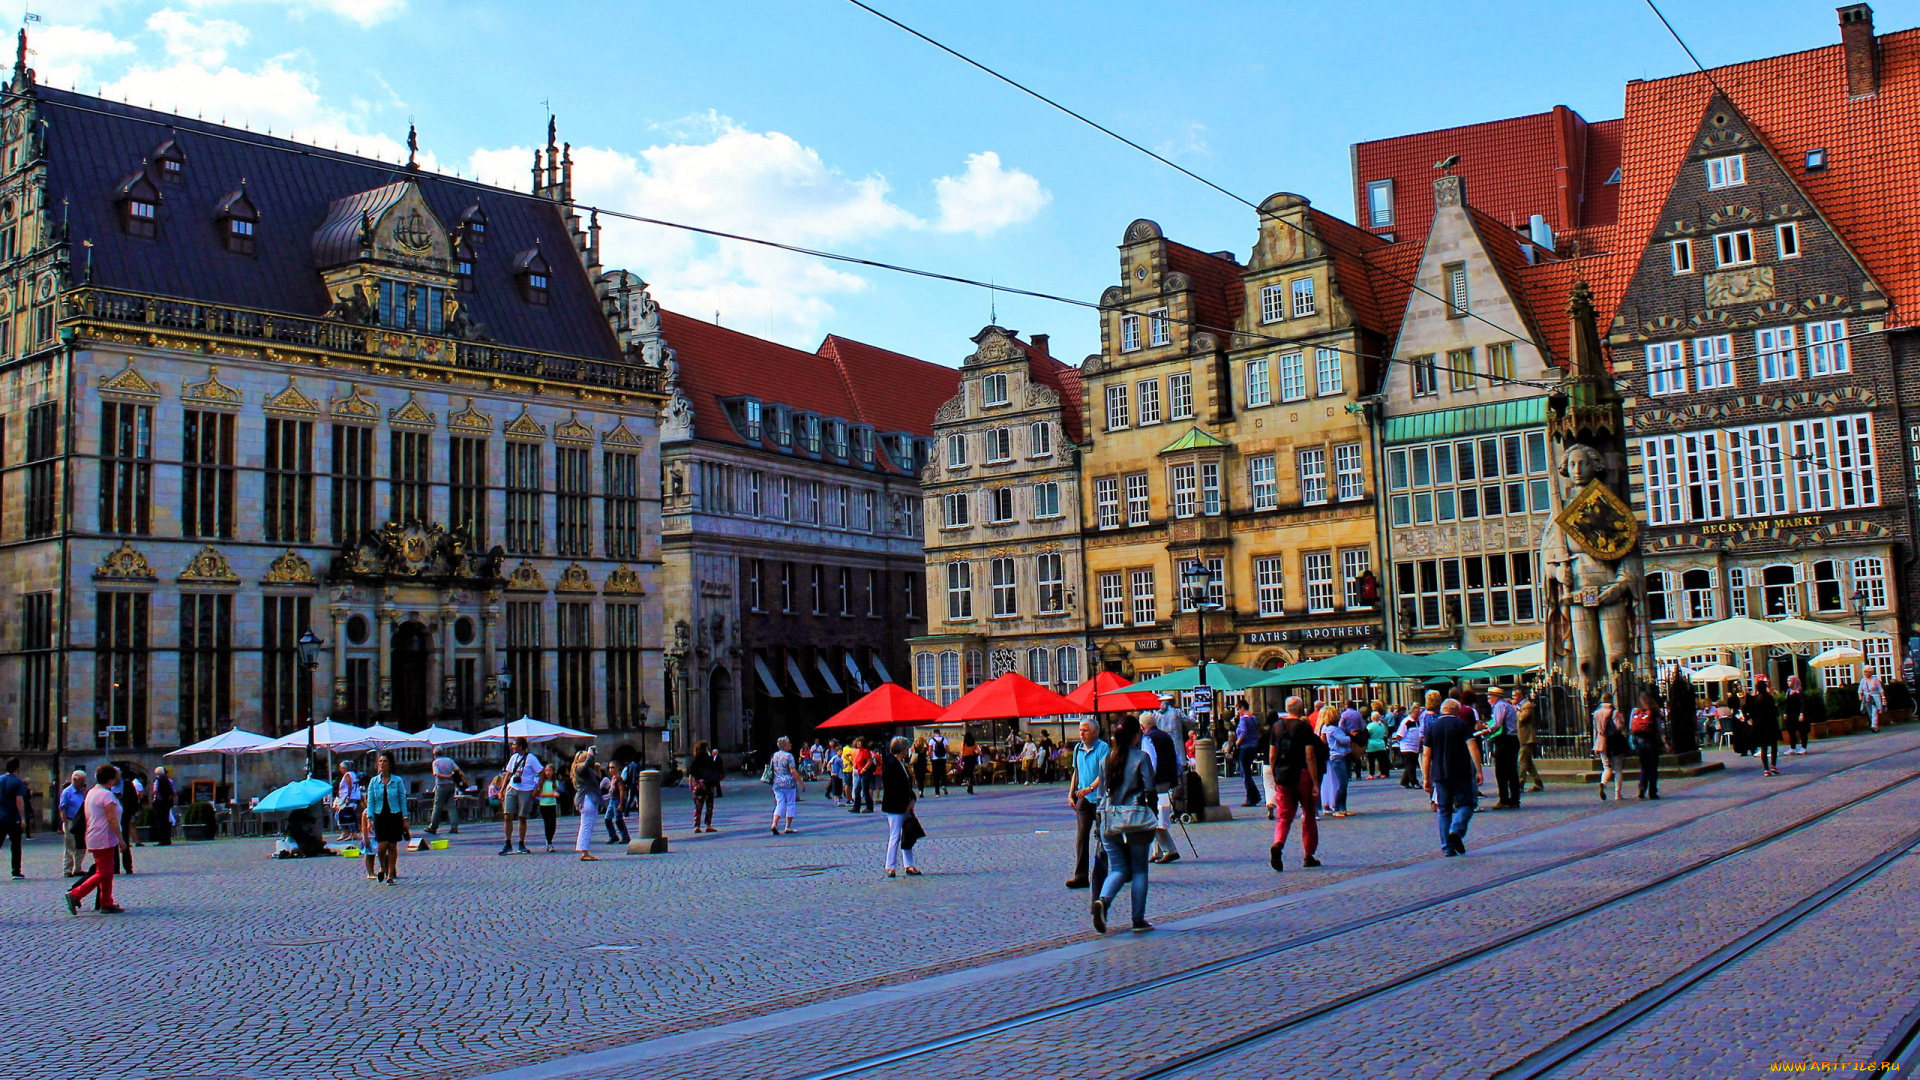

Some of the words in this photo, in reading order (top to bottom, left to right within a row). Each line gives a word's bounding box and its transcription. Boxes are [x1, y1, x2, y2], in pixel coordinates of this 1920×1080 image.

[1749, 520, 1769, 530] AM
[1774, 515, 1822, 529] MARKT
[1251, 631, 1288, 643] RATHS
[1306, 625, 1371, 639] APOTHEKE
